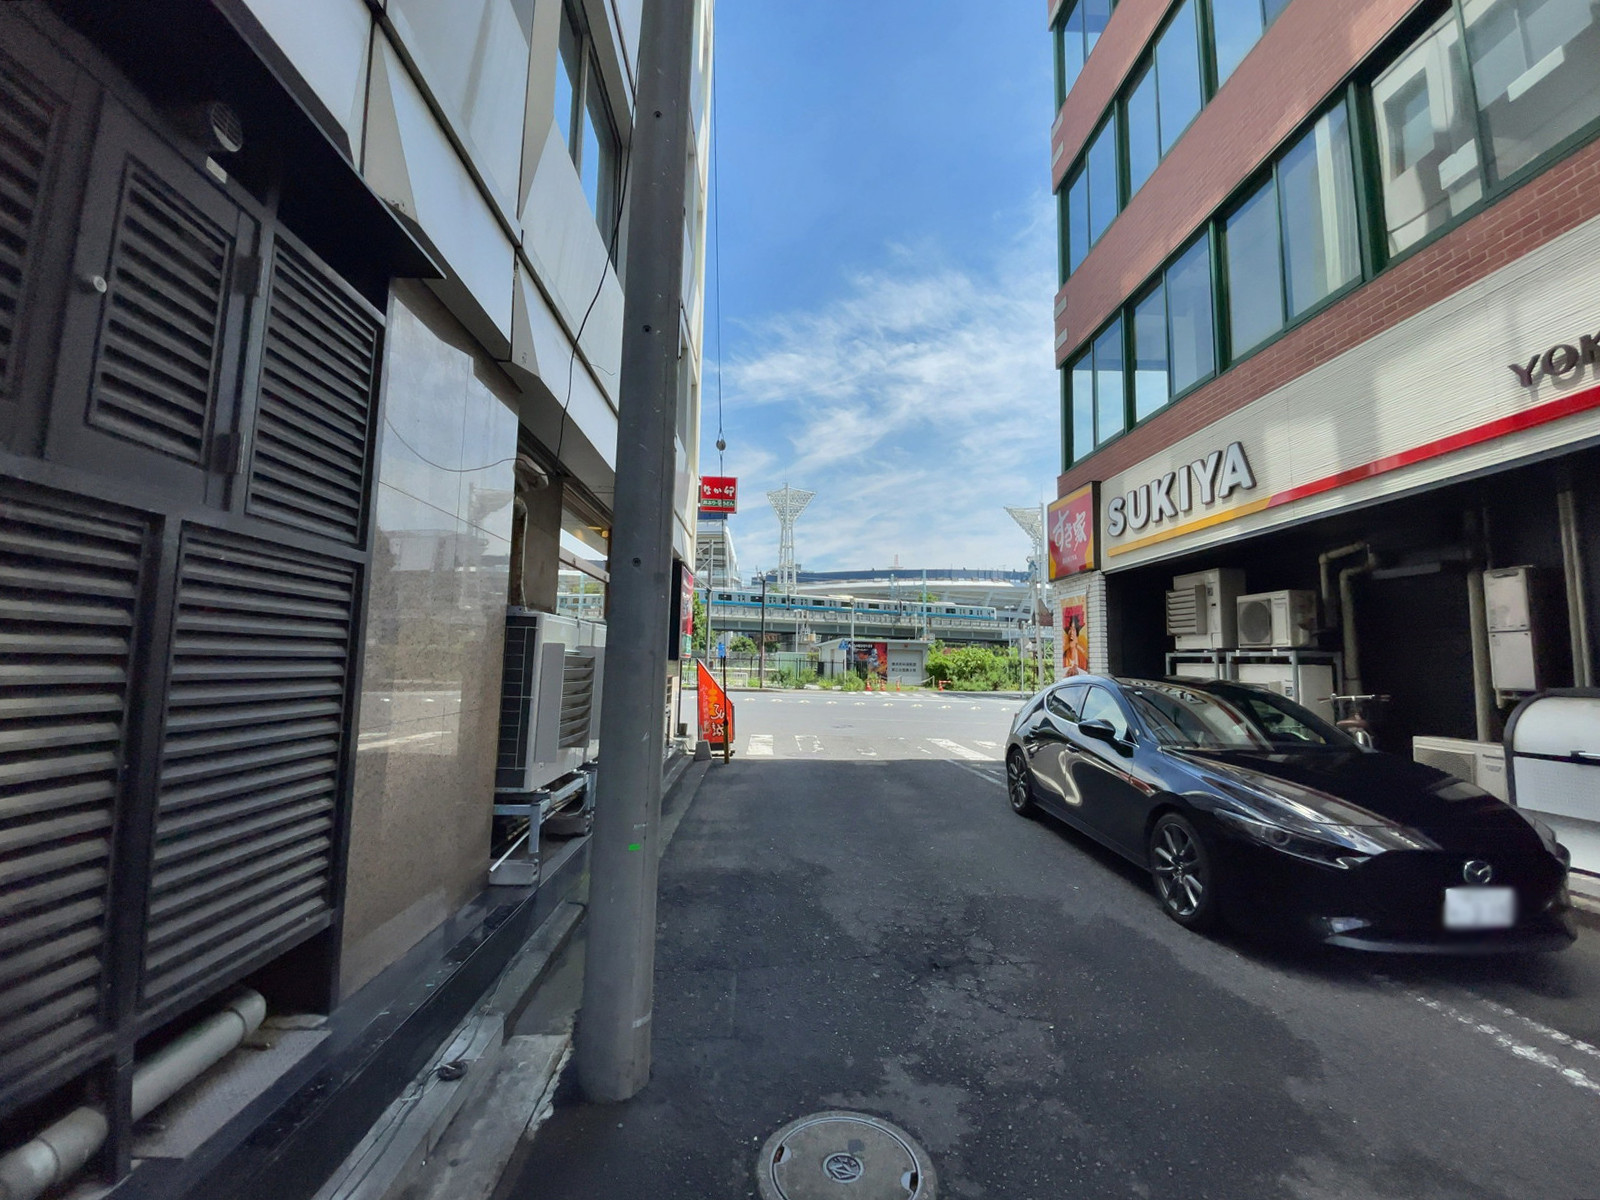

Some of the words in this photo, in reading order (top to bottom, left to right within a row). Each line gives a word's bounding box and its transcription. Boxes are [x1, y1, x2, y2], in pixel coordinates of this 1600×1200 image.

[703, 485, 735, 497] なか卯
[1107, 441, 1256, 537] SUKIYA
[1053, 510, 1087, 552] すき家
